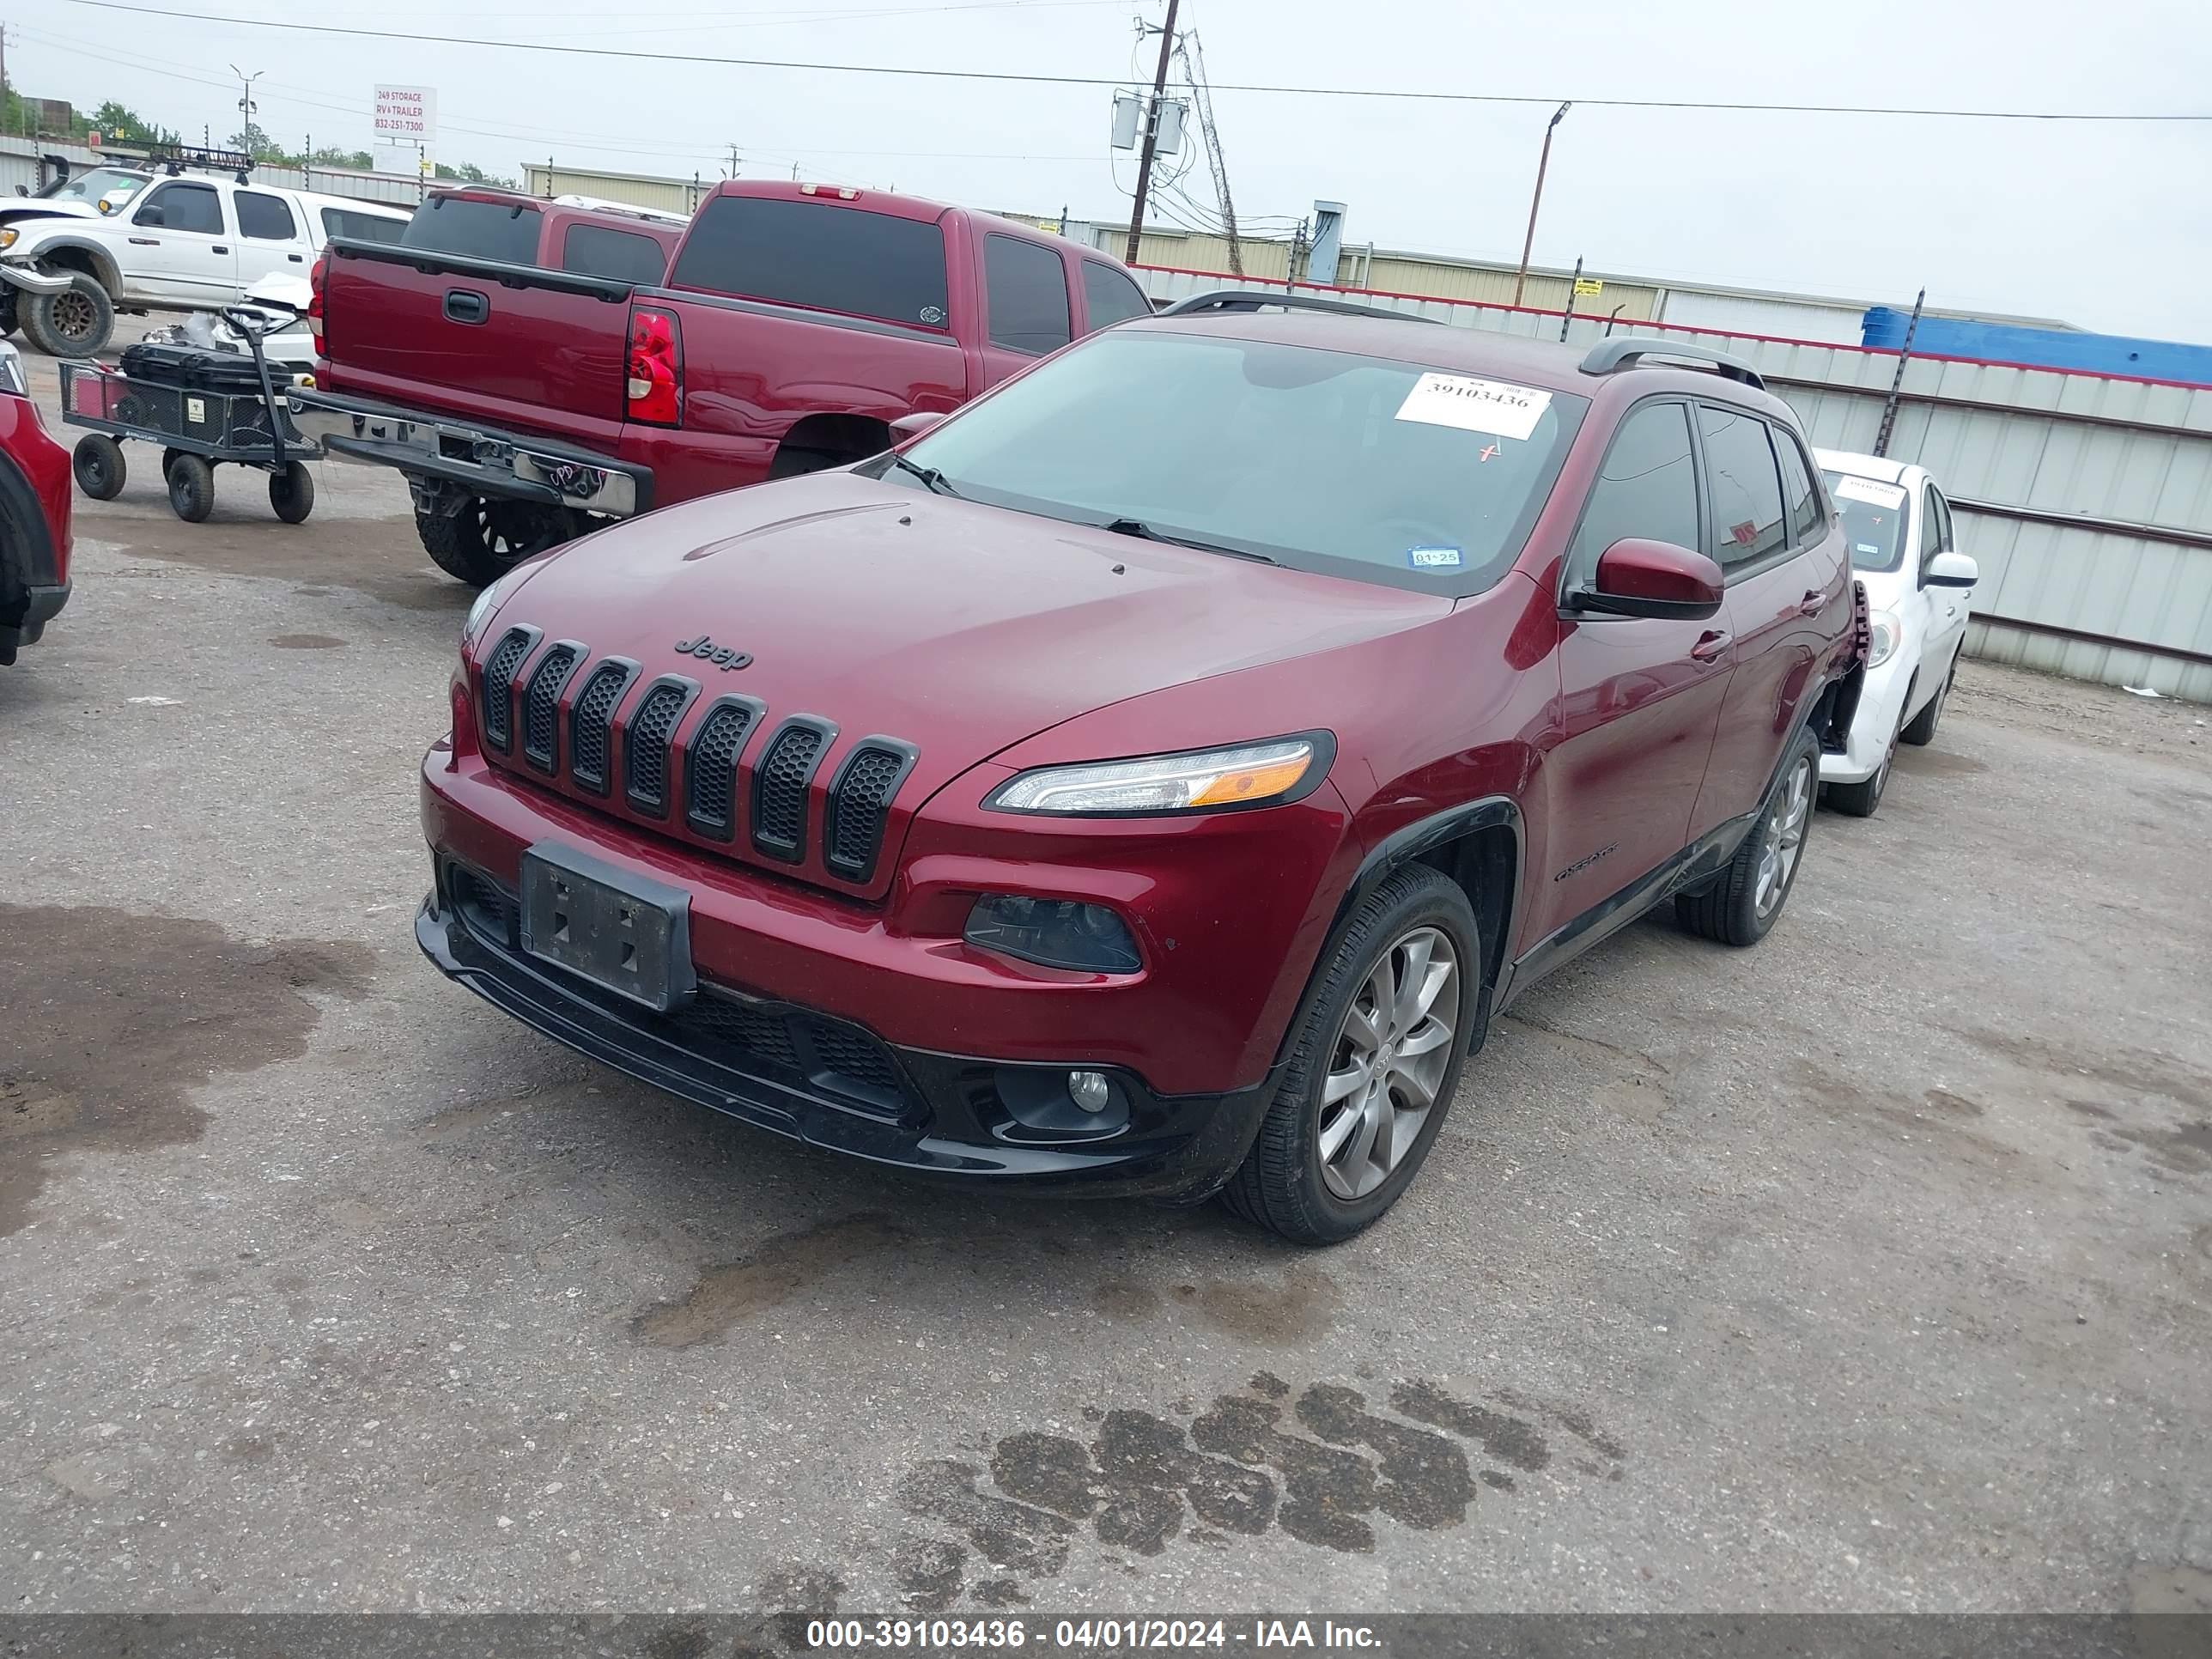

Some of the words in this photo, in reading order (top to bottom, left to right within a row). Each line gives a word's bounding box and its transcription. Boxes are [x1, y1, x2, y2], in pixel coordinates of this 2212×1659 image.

[378, 91, 390, 100] 249
[391, 92, 422, 102] STORAGE
[377, 105, 387, 114] RV
[392, 106, 422, 117] TRAILER
[375, 118, 423, 131] 832-251-7300
[1426, 383, 1528, 408] 39103436
[674, 635, 754, 672] Jeep
